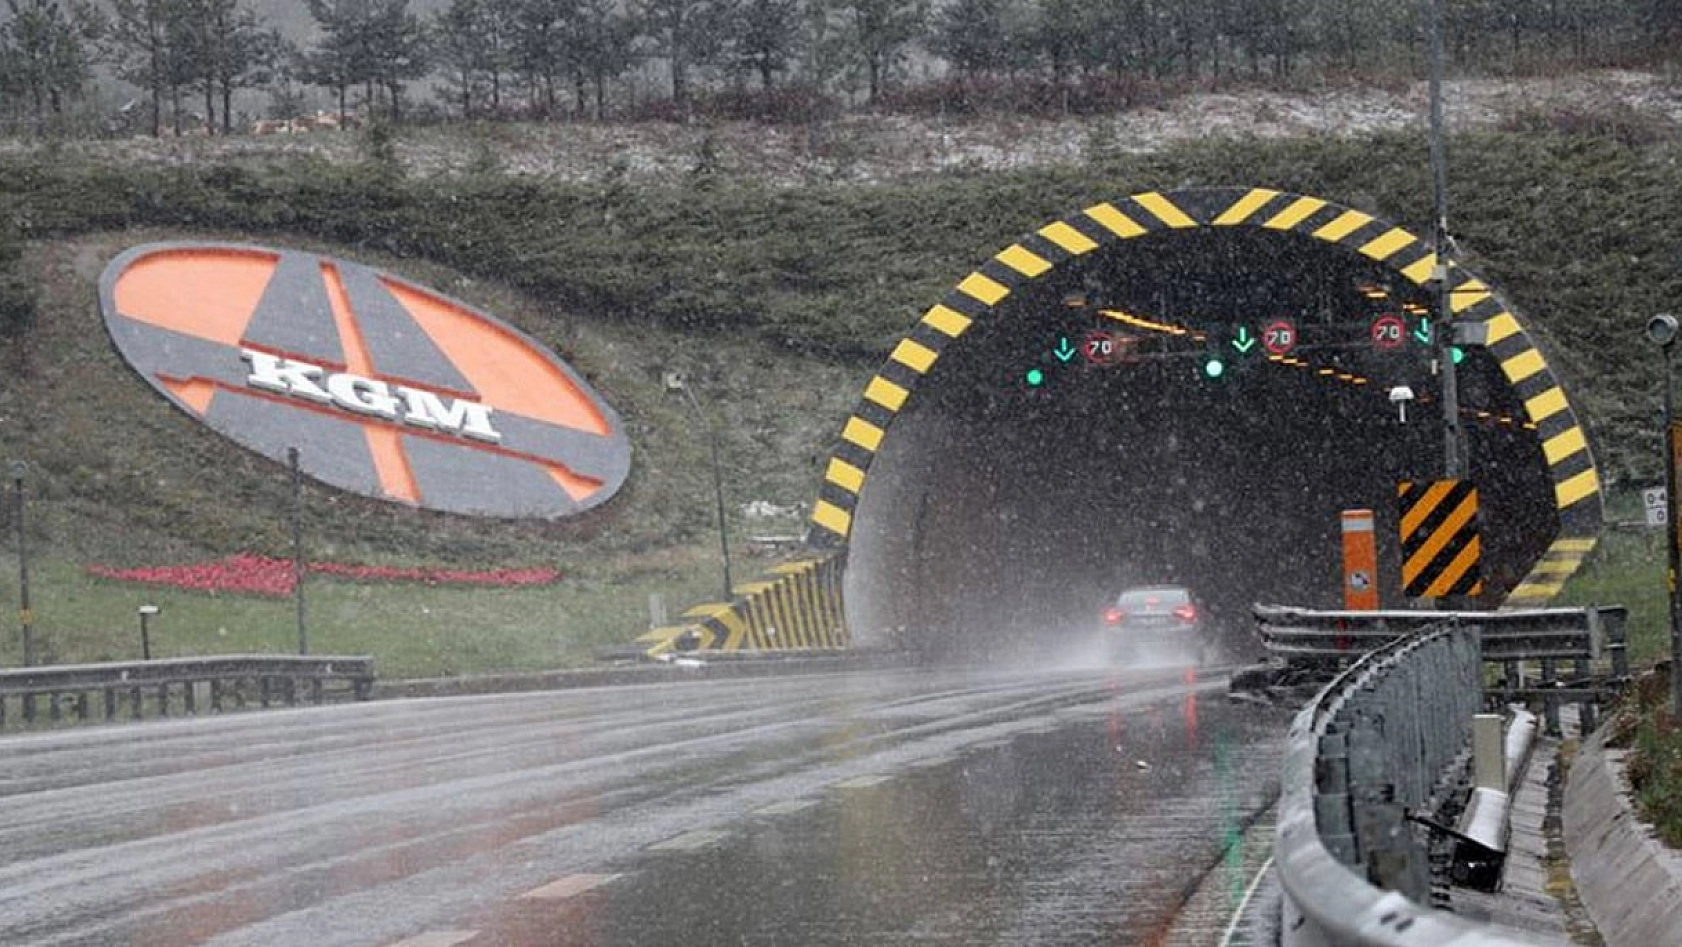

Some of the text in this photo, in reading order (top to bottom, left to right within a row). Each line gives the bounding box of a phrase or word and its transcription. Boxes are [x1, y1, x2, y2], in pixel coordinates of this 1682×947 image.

[1266, 331, 1291, 345] 70
[1376, 325, 1400, 340] 70
[1090, 340, 1112, 355] 70
[240, 349, 501, 444] KGM
